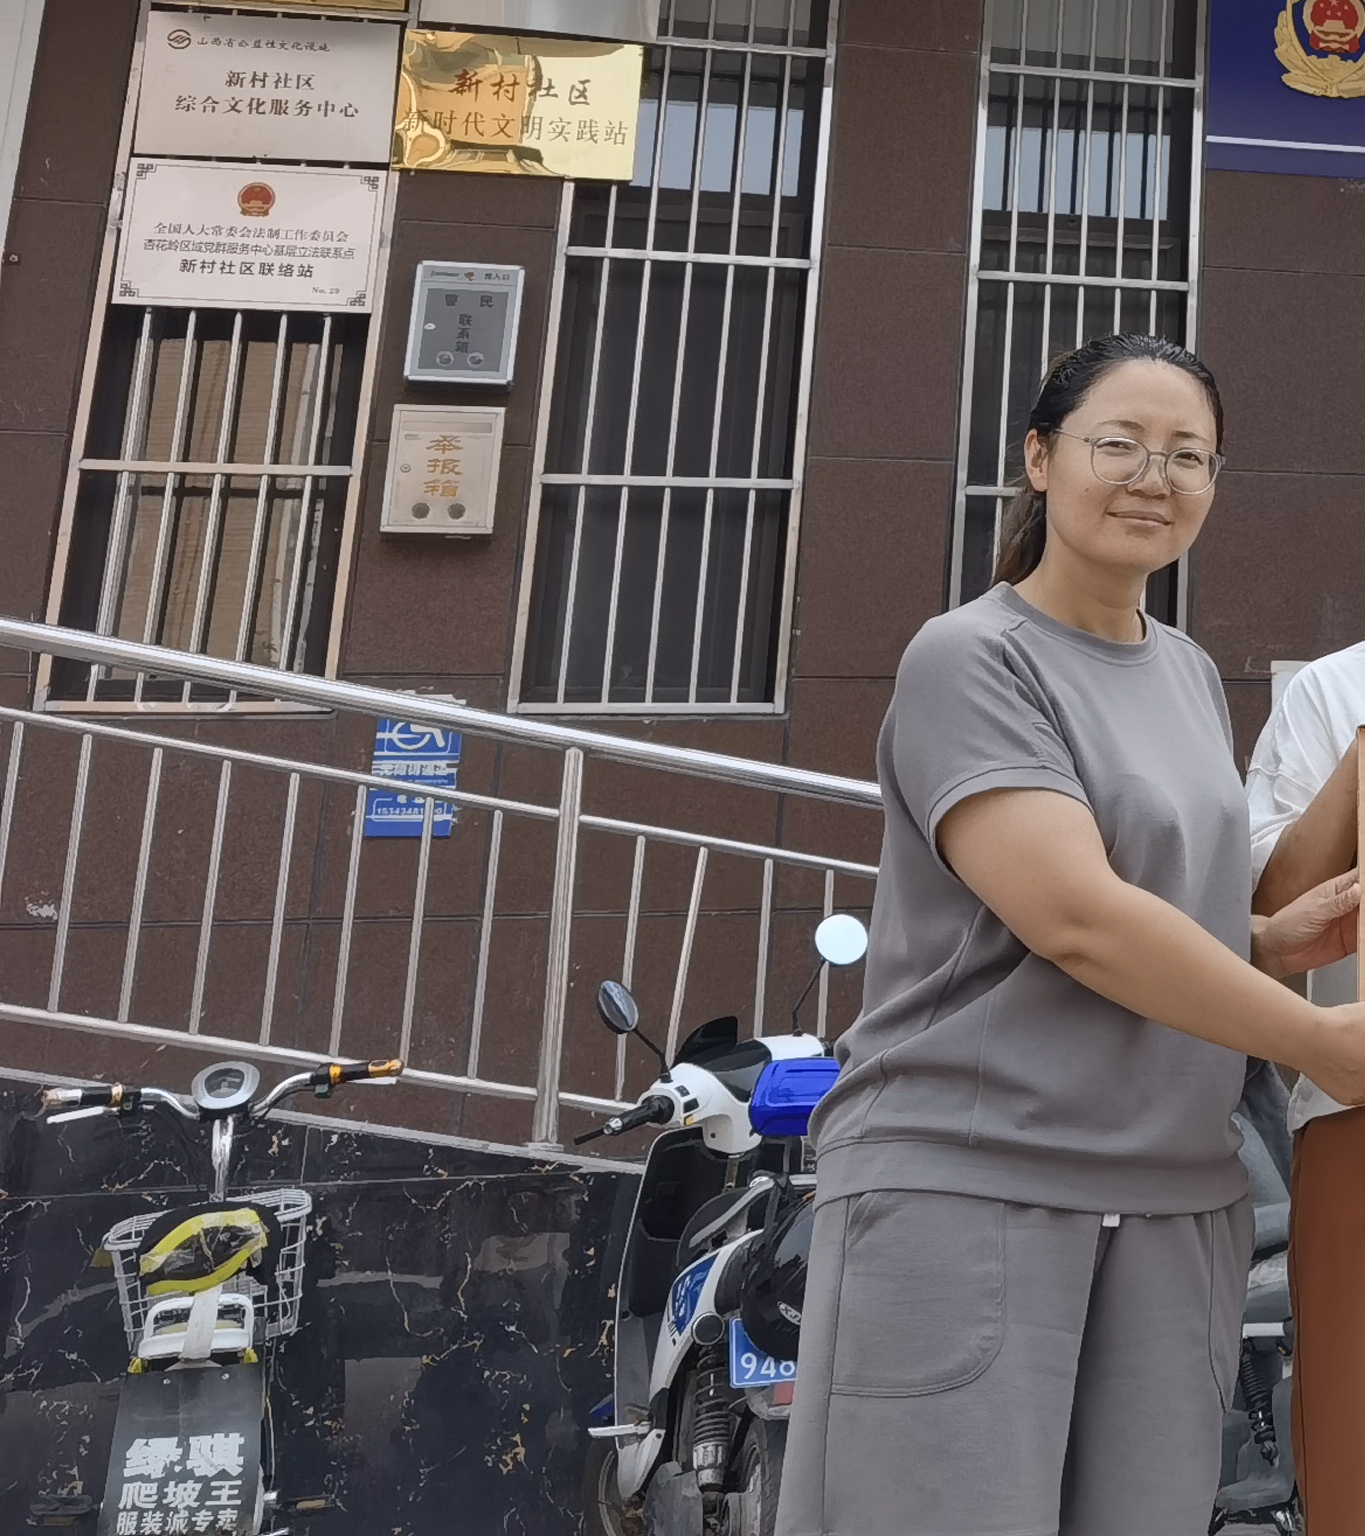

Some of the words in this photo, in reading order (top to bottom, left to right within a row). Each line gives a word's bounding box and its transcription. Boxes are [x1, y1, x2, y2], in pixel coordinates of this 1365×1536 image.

[224, 69, 316, 91] 新村社区
[450, 68, 592, 106] 新村社区
[174, 95, 360, 118] 综合文化服务中心
[403, 109, 629, 146] 新时代文明实践站
[153, 221, 350, 243] 全国人大常委会法制工作委员会
[178, 259, 315, 279] 新村社区联络站
[118, 1479, 243, 1509] 爬坡王
